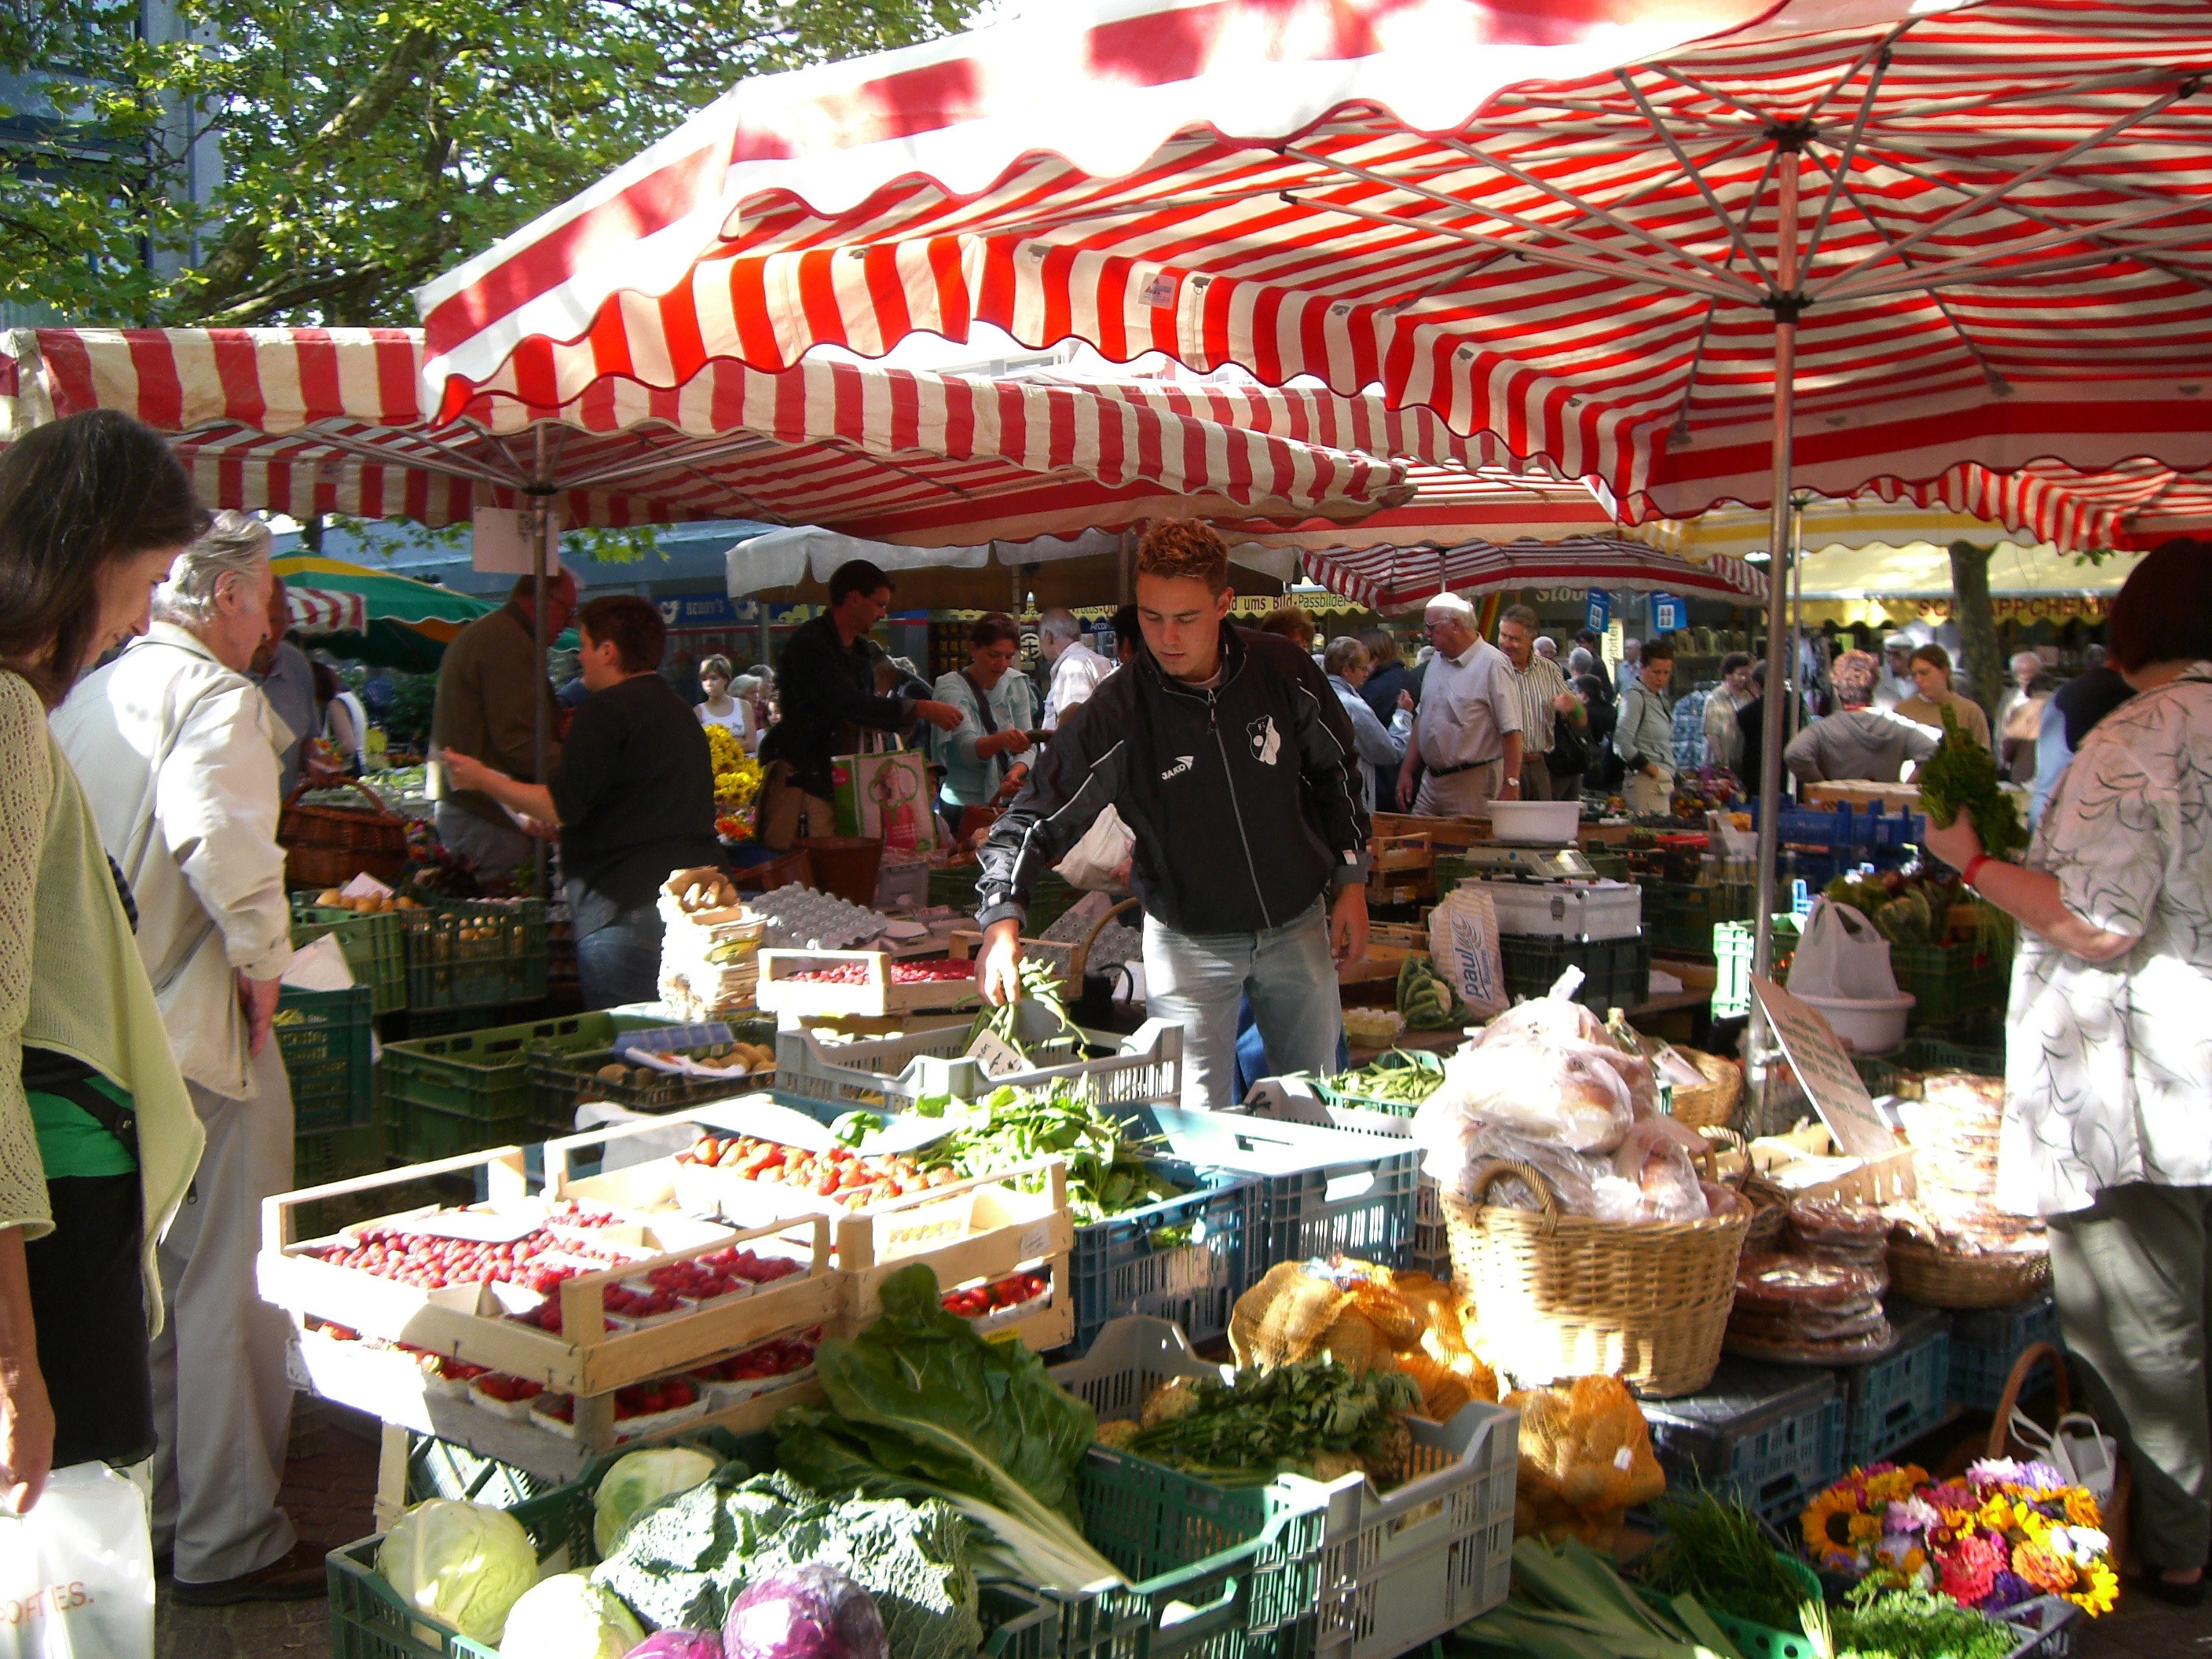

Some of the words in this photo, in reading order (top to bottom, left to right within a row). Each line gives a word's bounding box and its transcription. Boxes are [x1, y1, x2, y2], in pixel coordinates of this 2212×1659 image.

[1244, 598, 1266, 611] ums
[1273, 593, 1293, 610] Bild
[1161, 764, 1186, 780] JAKO
[1455, 947, 1484, 998] paul
